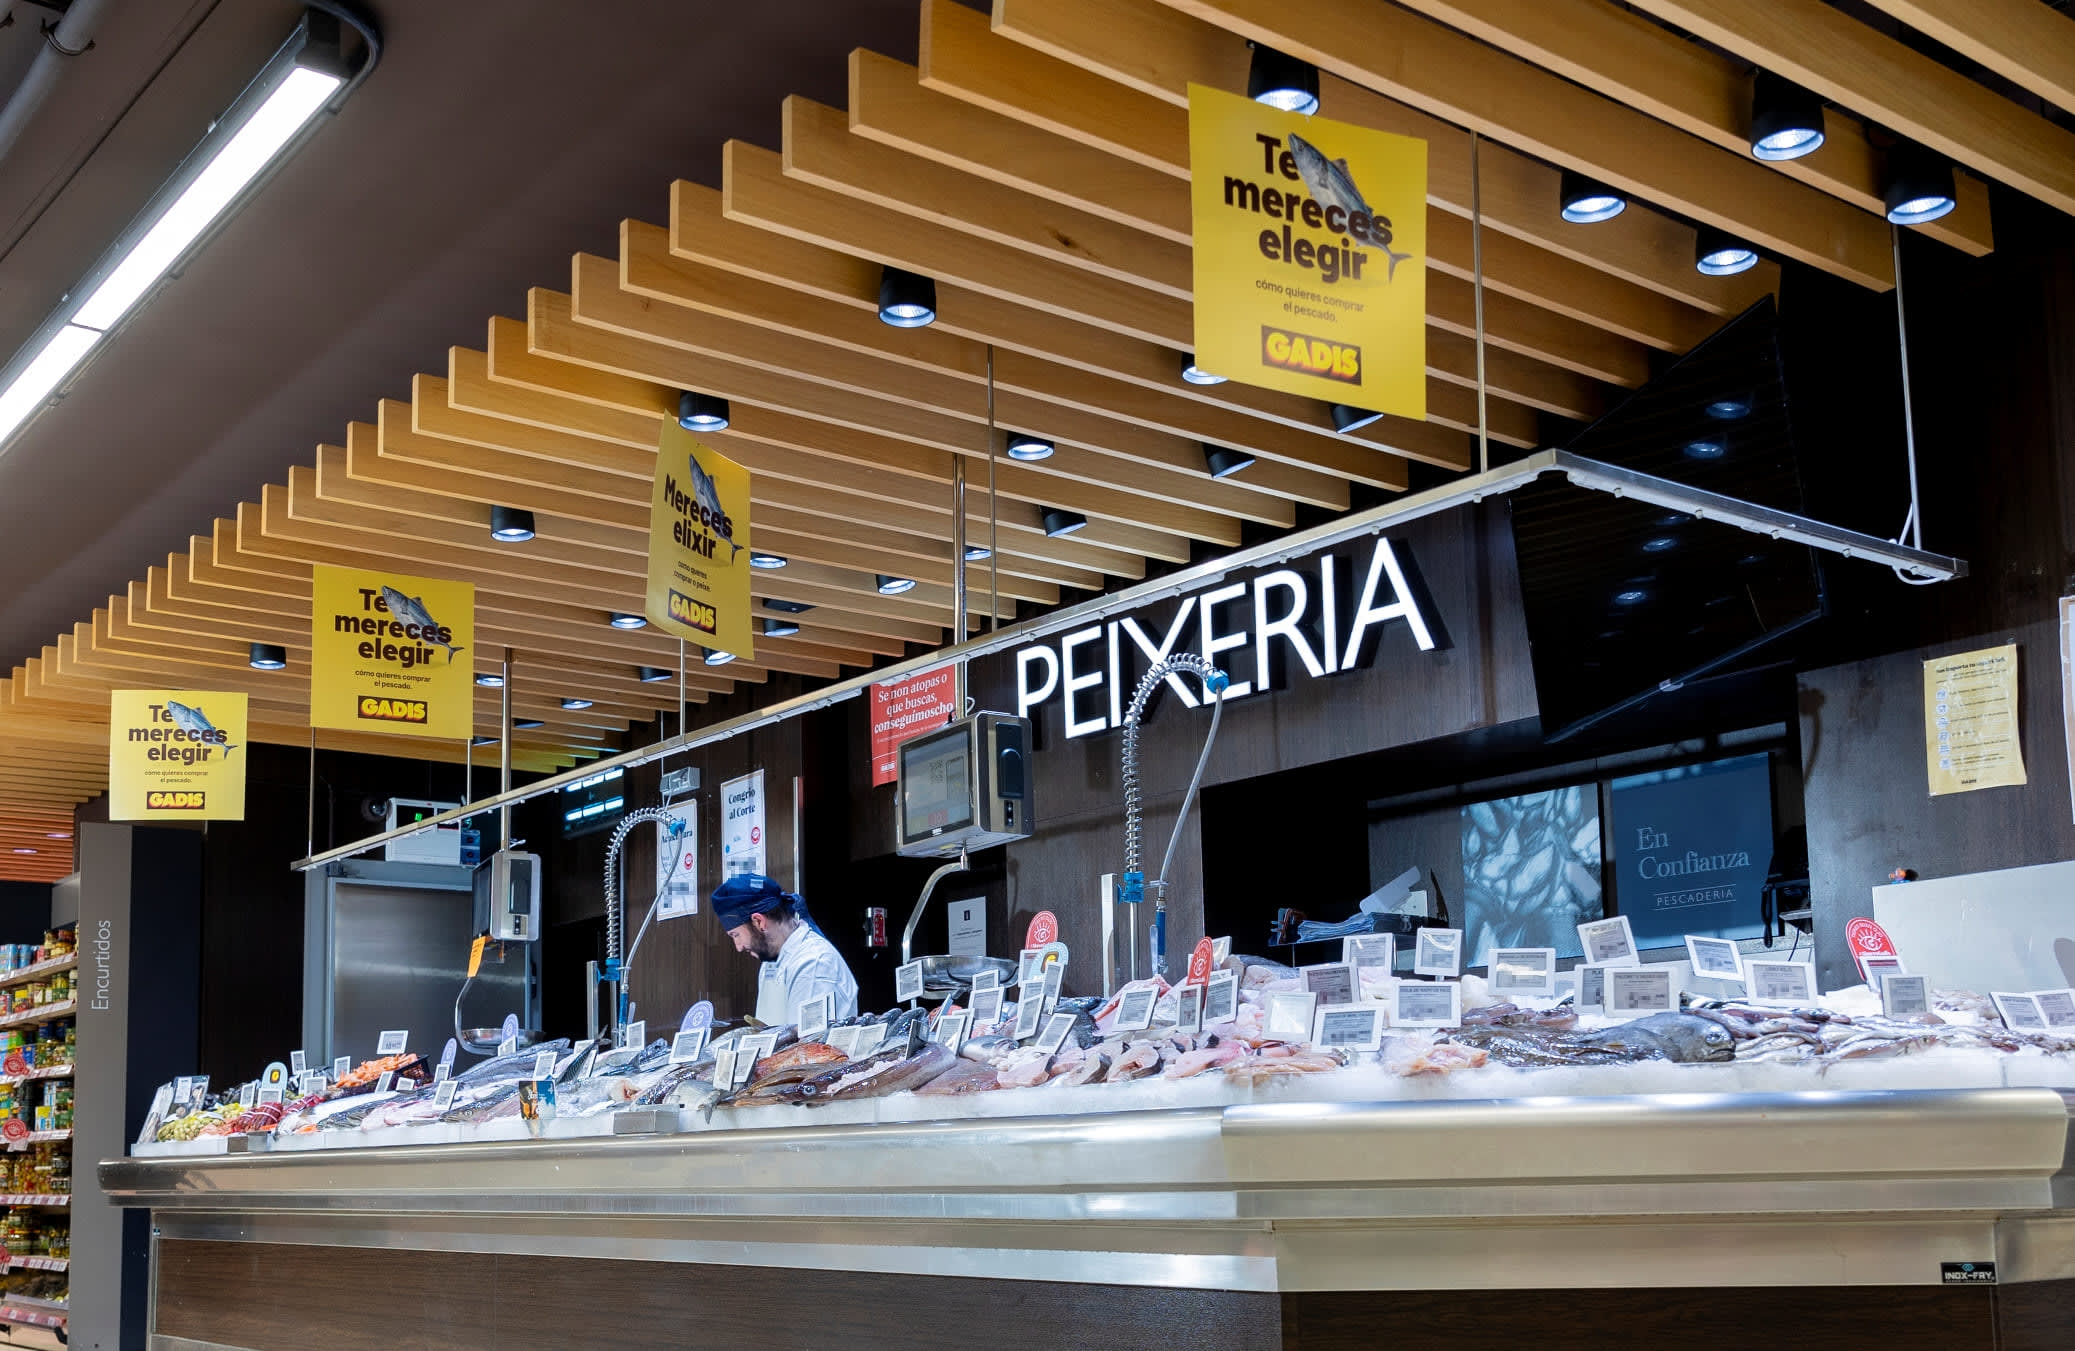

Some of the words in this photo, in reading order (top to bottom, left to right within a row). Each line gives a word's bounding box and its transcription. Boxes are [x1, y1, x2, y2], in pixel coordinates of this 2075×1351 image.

[1256, 133, 1299, 181] Te
[1224, 176, 1393, 246] mereces
[1259, 226, 1368, 284] elegir
[1256, 279, 1284, 295] cómo
[1285, 287, 1322, 303] quieres
[1323, 296, 1364, 313] comprar
[1283, 302, 1292, 313] el
[1294, 304, 1338, 322] pescado.
[1266, 332, 1359, 378] GADIS
[664, 474, 733, 538] Mereces
[673, 518, 717, 560] elixir
[359, 588, 389, 613] Te
[671, 594, 715, 629] GADIS
[335, 615, 452, 643] mereces
[1016, 536, 1436, 740] PEIXERIA
[358, 638, 434, 668] elegir
[376, 671, 401, 680] quieres
[402, 674, 431, 682] comprar
[878, 690, 889, 703] Se
[890, 686, 909, 700] non
[910, 677, 940, 694] atopas
[941, 673, 948, 684] o
[148, 704, 173, 722] Te
[361, 698, 425, 720] GADIS
[874, 701, 954, 735] conseguímoscho
[886, 702, 904, 718] que
[905, 692, 938, 710] buscas,
[128, 728, 228, 743] mereces
[147, 743, 212, 766] elegir
[149, 792, 204, 808] GADIS
[728, 789, 756, 805] Congrio
[729, 808, 736, 820] al
[736, 805, 756, 818] Corte
[1636, 827, 1669, 851] En
[1638, 851, 1751, 880] Confianza
[1656, 889, 1734, 907] PESCADERIA
[91, 920, 111, 1010] Encurtidos
